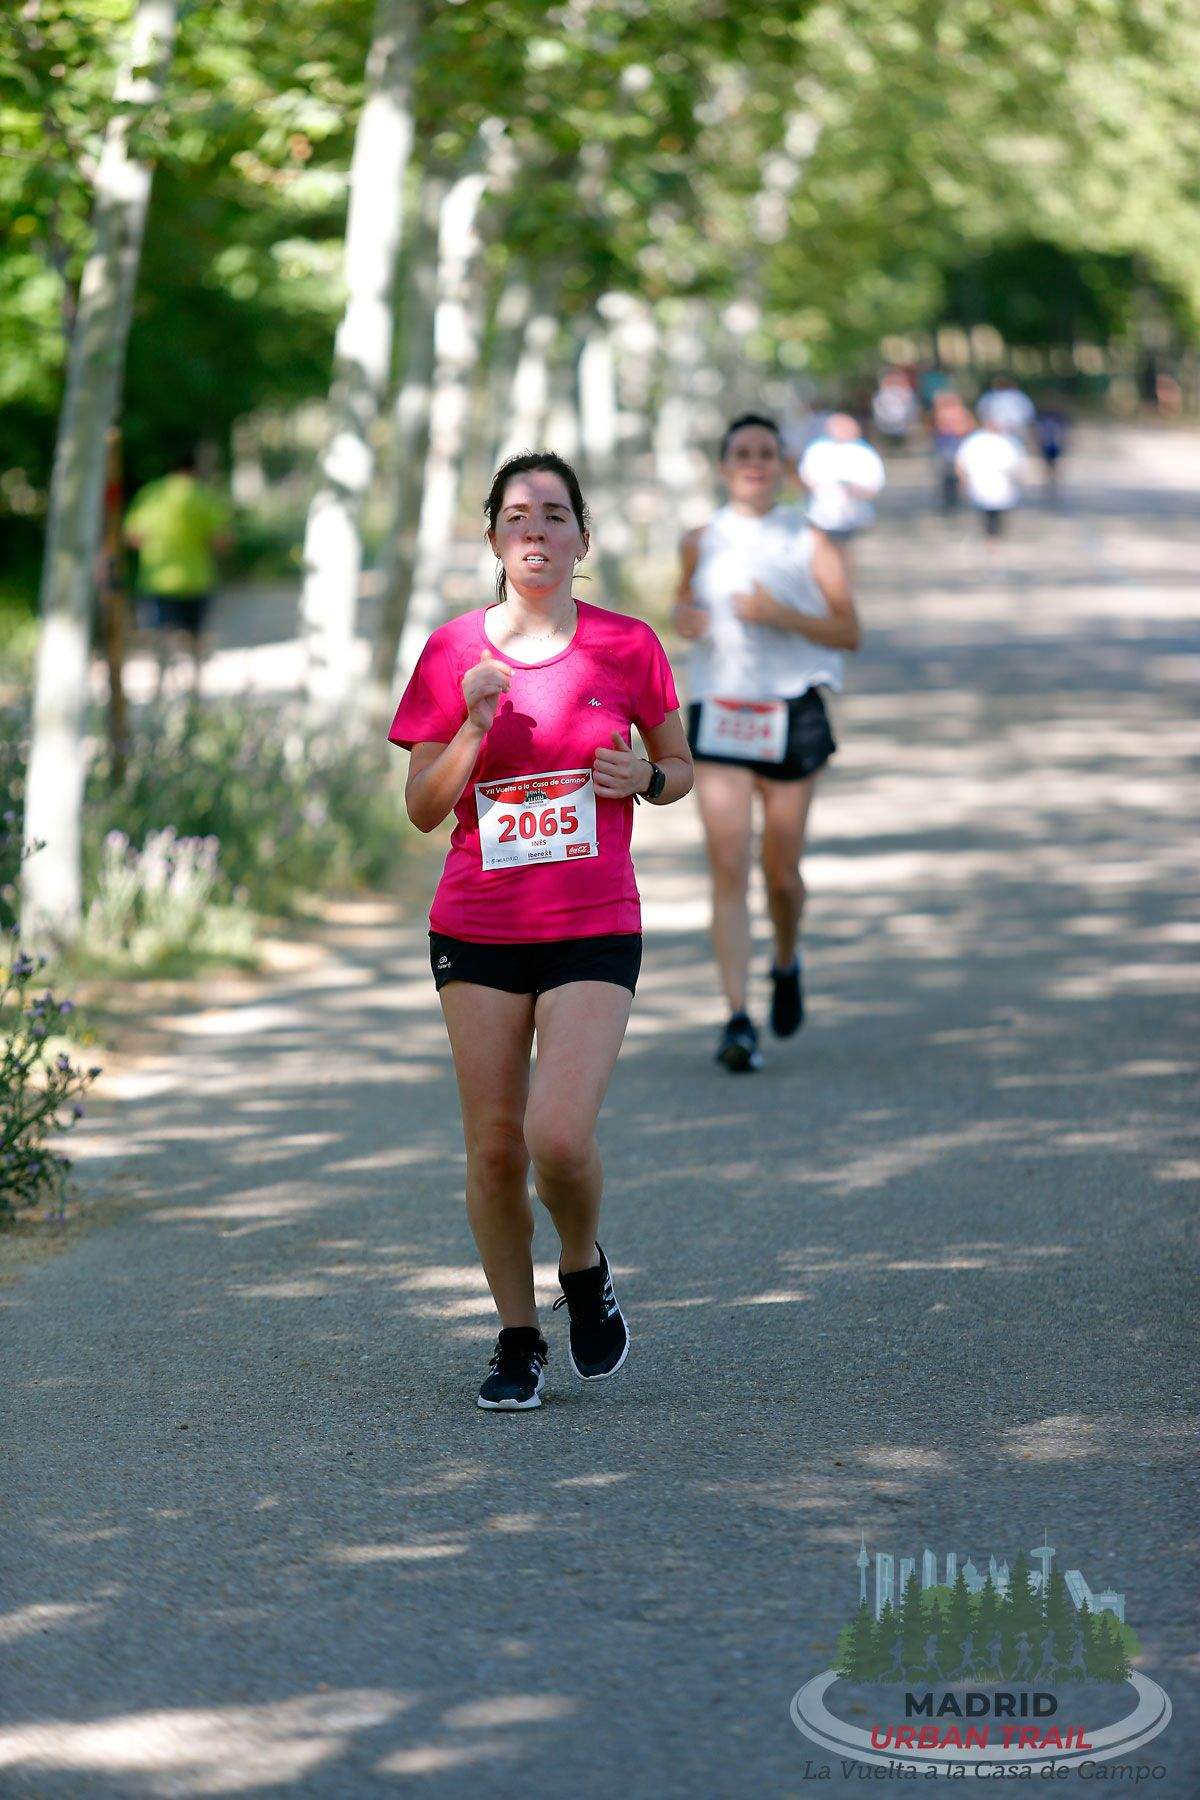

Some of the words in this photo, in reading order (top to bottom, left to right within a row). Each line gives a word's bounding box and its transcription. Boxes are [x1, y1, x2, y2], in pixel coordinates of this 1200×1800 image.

[495, 785, 516, 794] Vuelta
[523, 782, 530, 790] la
[532, 780, 549, 788] Casa
[560, 776, 585, 785] Campo
[497, 806, 579, 843] 2065
